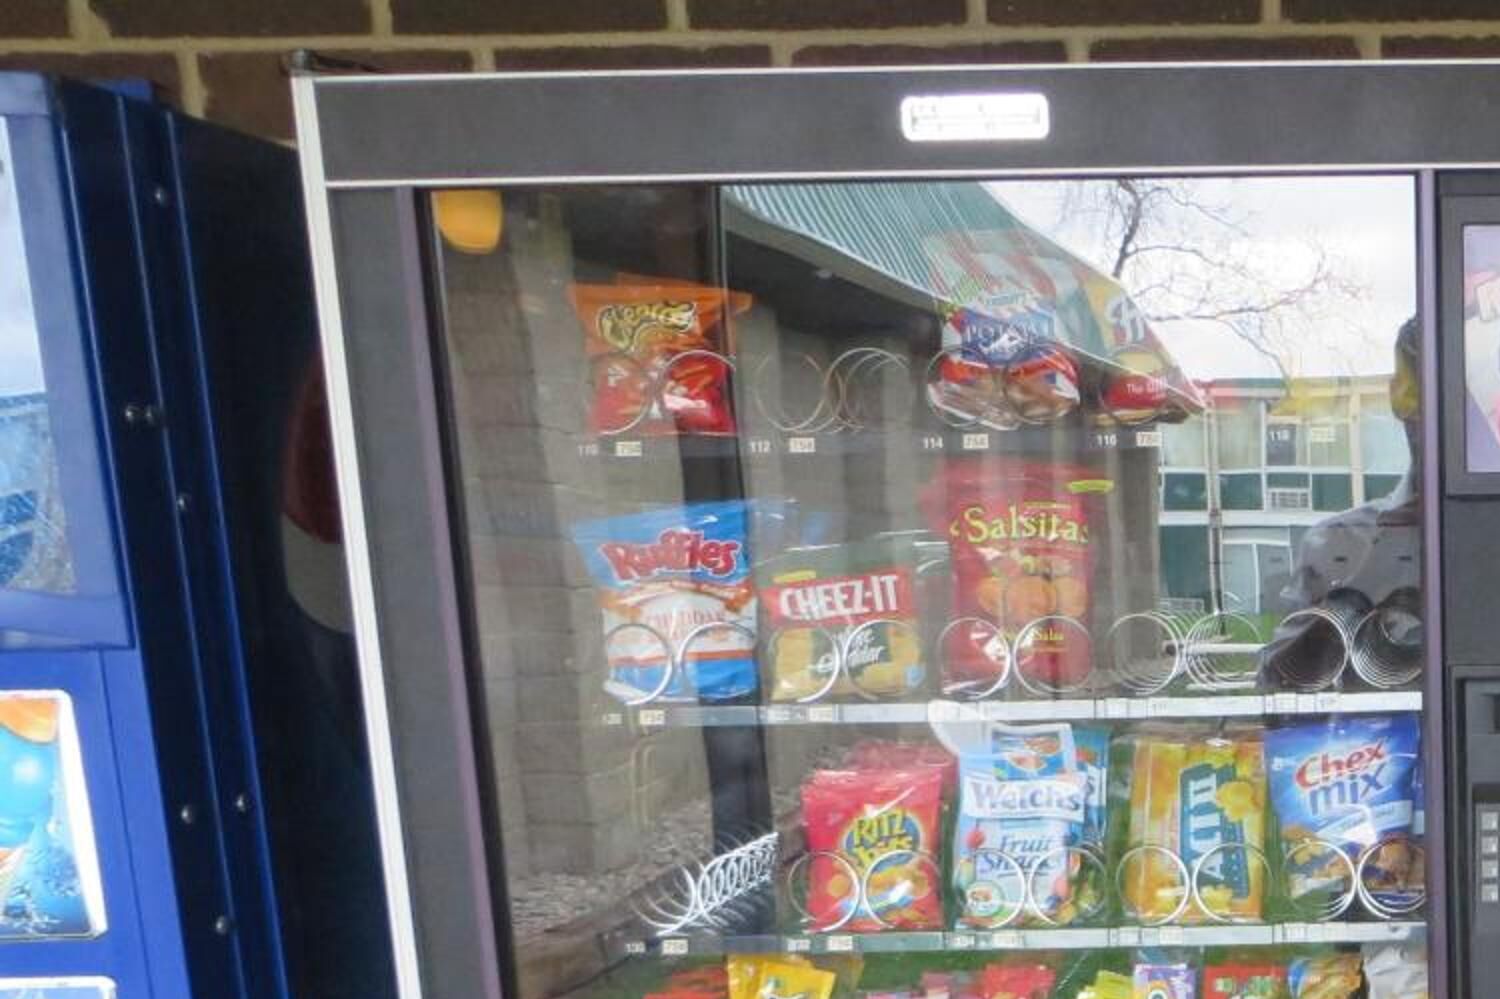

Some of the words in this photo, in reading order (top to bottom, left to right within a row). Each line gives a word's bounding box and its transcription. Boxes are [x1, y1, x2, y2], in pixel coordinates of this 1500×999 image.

[922, 437, 944, 449] 114
[599, 528, 742, 581] Ruffles
[779, 573, 898, 621] CHEEZ-IT
[1296, 740, 1388, 788] Chex
